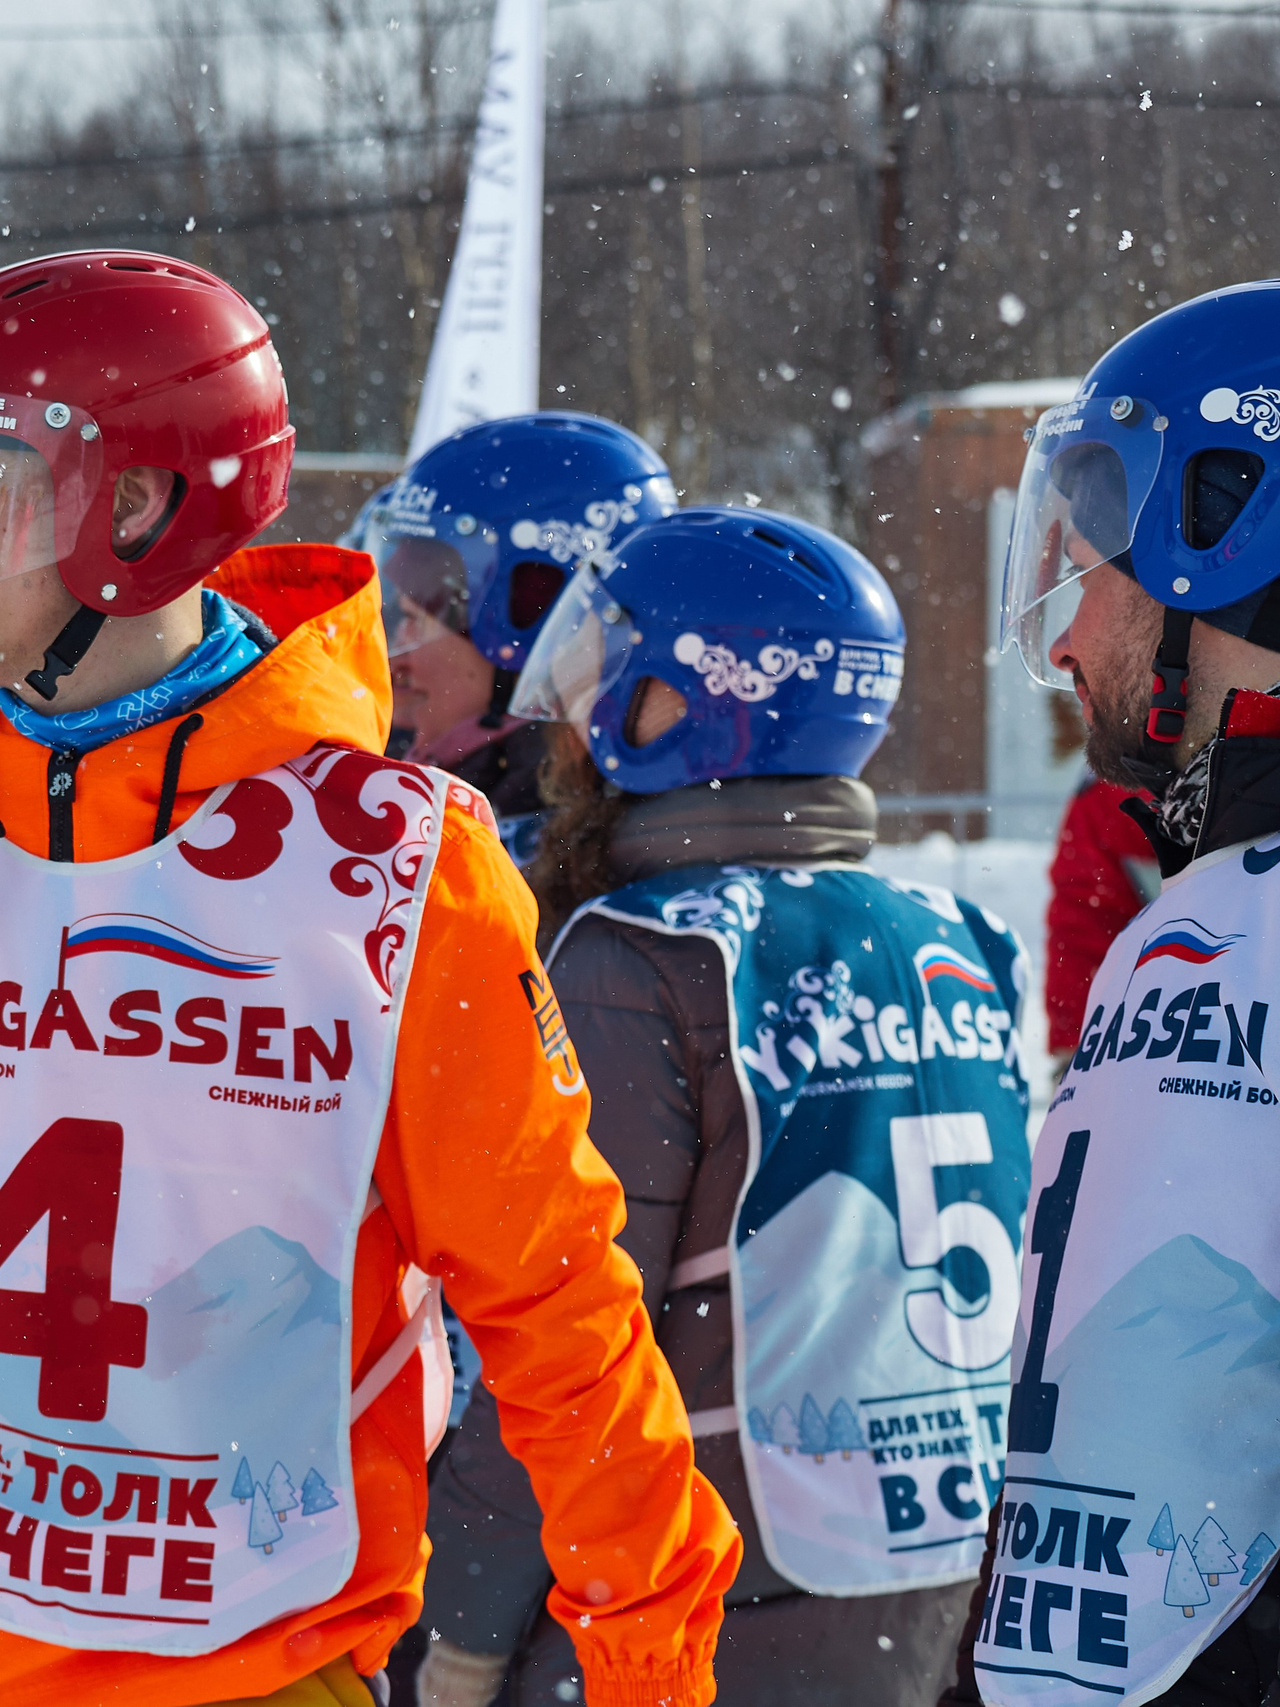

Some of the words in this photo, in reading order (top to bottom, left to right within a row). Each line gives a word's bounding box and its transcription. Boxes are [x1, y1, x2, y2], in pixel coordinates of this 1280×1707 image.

[208, 1085, 311, 1113] СНЕЖНЫЙ
[314, 1092, 342, 1113] БОЙ
[1159, 1077, 1243, 1102] СНЕЖНЫЙ
[889, 1112, 1020, 1372] 5
[1007, 1129, 1091, 1455] 1
[868, 1414, 919, 1442] ДЛЯ
[23, 1450, 218, 1528] ТОЛК
[879, 1473, 926, 1534] В
[1001, 1501, 1132, 1577] ТОЛК
[975, 1573, 1129, 1669] НЕГЕ
